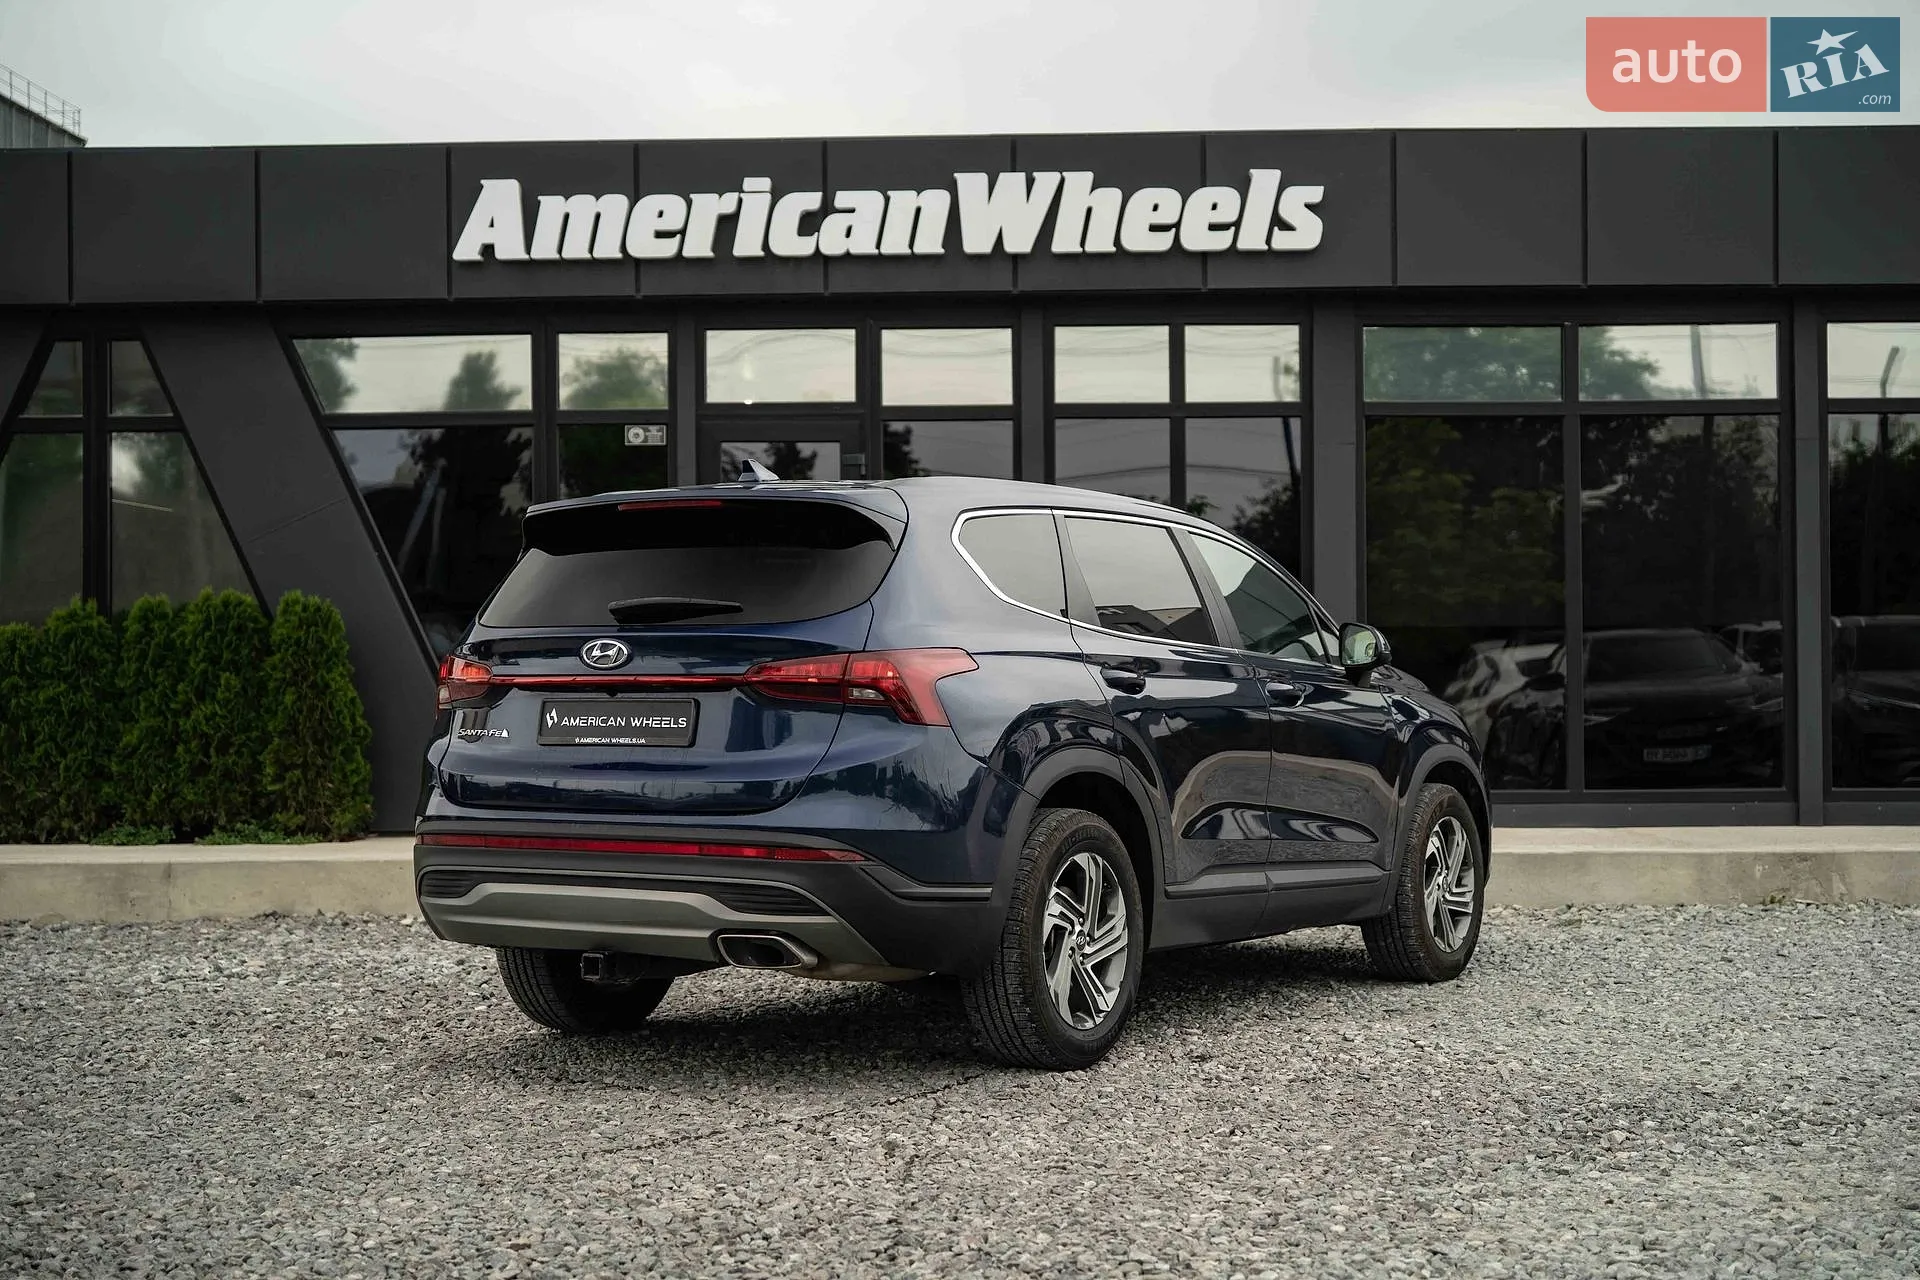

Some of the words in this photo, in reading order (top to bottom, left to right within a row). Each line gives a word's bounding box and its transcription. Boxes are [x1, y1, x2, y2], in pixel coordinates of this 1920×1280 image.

[452, 168, 1326, 262] AmericanWheels
[560, 716, 626, 728] AMERICAN
[630, 716, 687, 728] WHEELS
[457, 728, 488, 736] SANTA
[488, 729, 502, 737] FE
